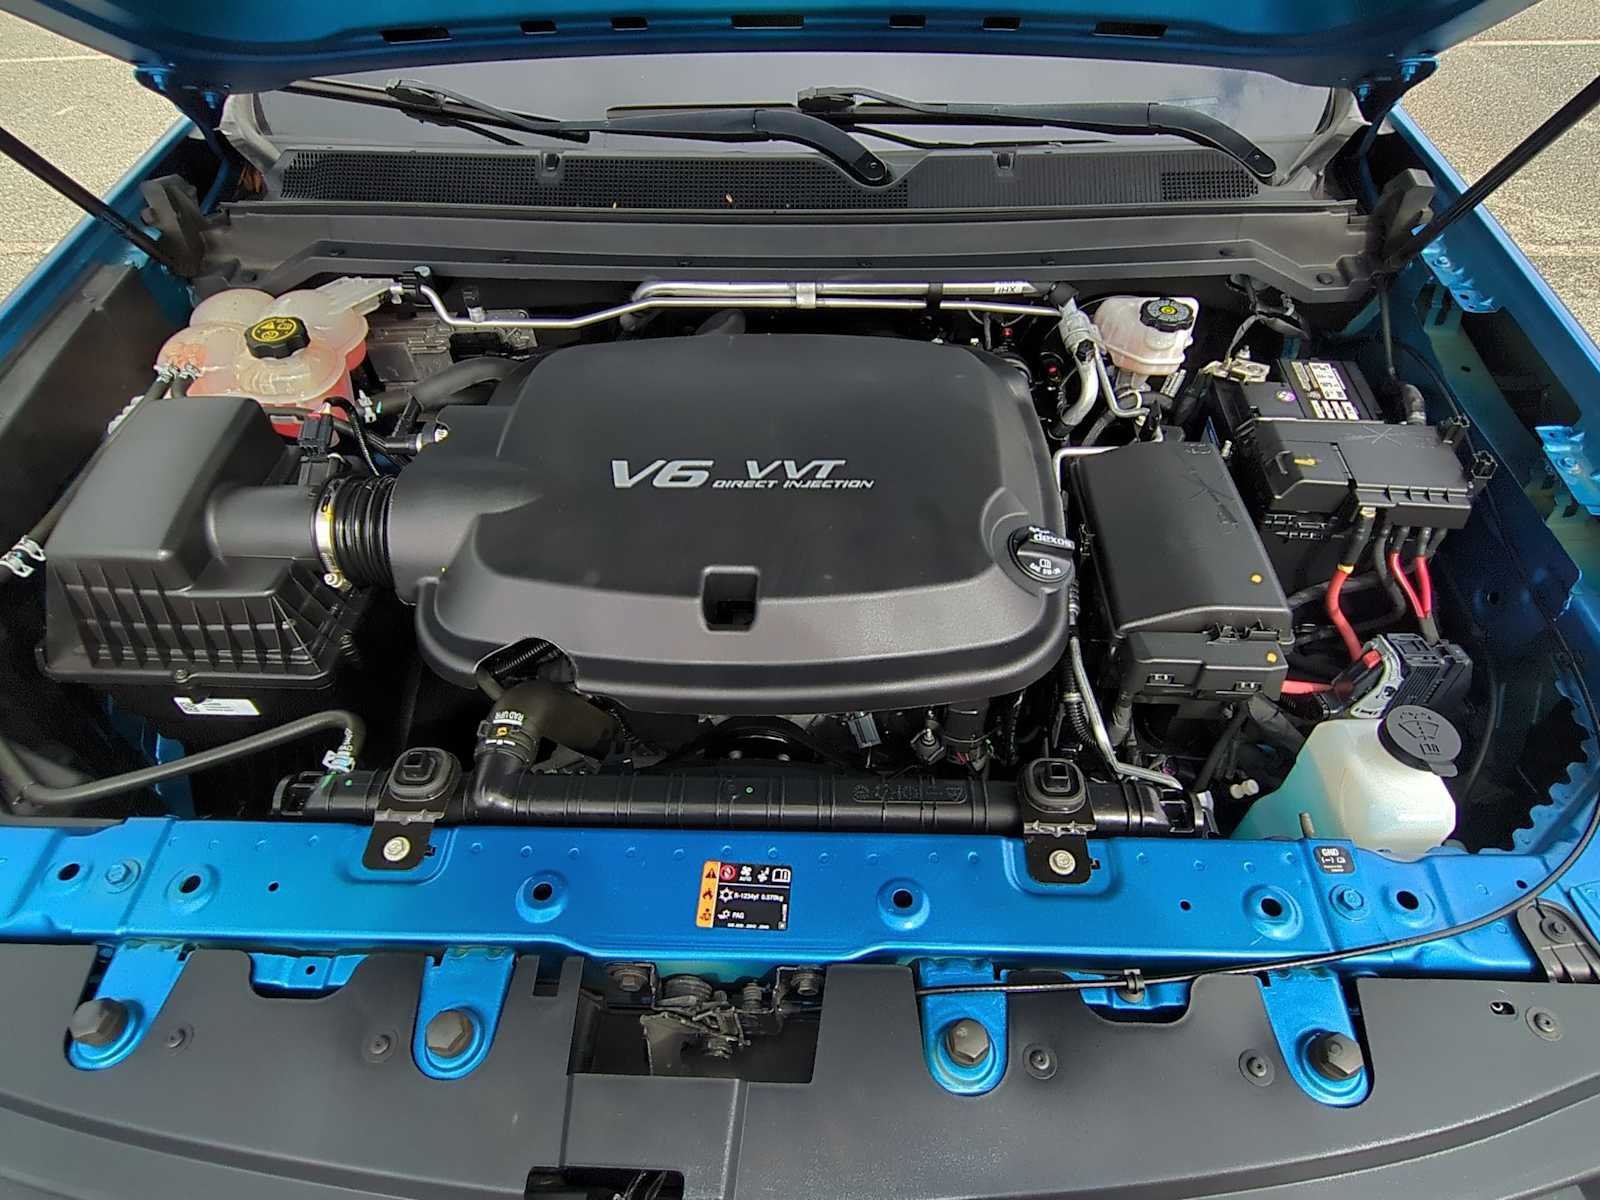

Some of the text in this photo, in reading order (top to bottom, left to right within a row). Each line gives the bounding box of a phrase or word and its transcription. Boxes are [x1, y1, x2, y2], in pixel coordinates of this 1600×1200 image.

[611, 459, 846, 488] V6 VVT
[712, 479, 874, 488] DIRECT INJECTION
